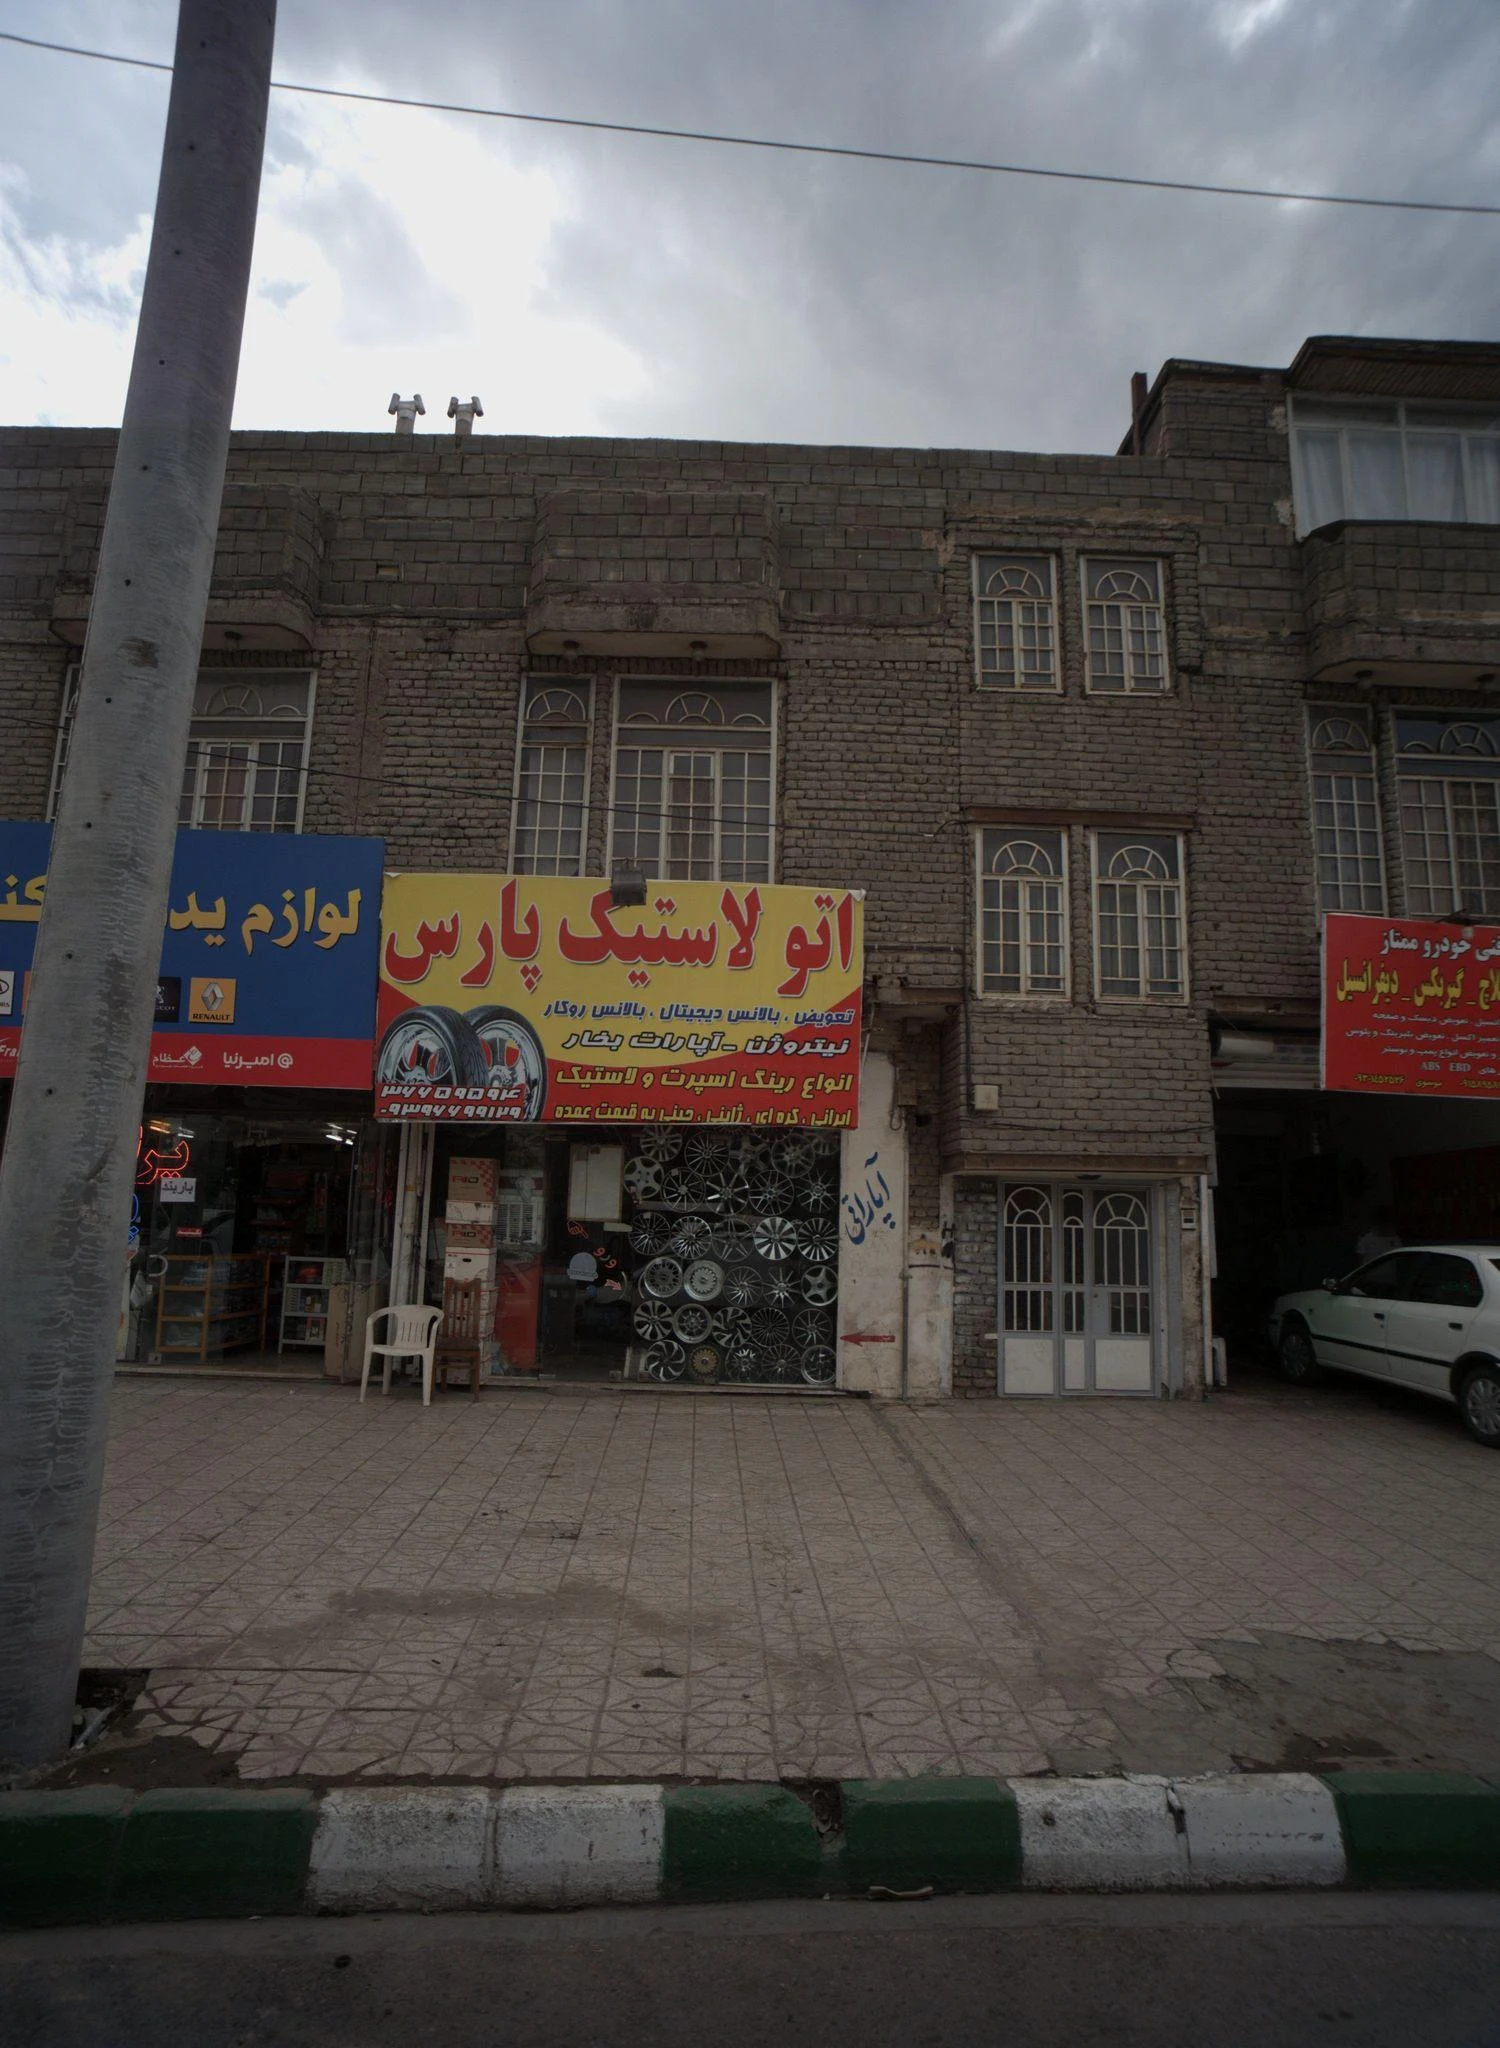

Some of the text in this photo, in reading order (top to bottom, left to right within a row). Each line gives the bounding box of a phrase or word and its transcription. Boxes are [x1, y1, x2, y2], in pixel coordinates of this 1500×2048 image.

[242, 887, 362, 956] لوازم
[385, 877, 854, 998] اتو لاستیک پارس
[1380, 928, 1419, 955] ممتاز
[1421, 937, 1472, 960] خودرو
[1479, 968, 1500, 1011] لاچ
[192, 1013, 231, 1022] RENAULT
[543, 999, 587, 1018] روکار
[591, 1001, 646, 1020] بالانس
[660, 1003, 723, 1024] دیجیتال
[727, 1006, 781, 1026] بالانس
[793, 1008, 855, 1028] تعویض
[561, 1029, 624, 1052] بخار
[628, 1030, 726, 1057] آپارات
[744, 1033, 851, 1058] نیتروژن
[222, 1051, 274, 1069] امیرنیا
[556, 1065, 855, 1099] انواع رینگ اسپرت و لاستیک
[554, 1104, 593, 1120] عمده
